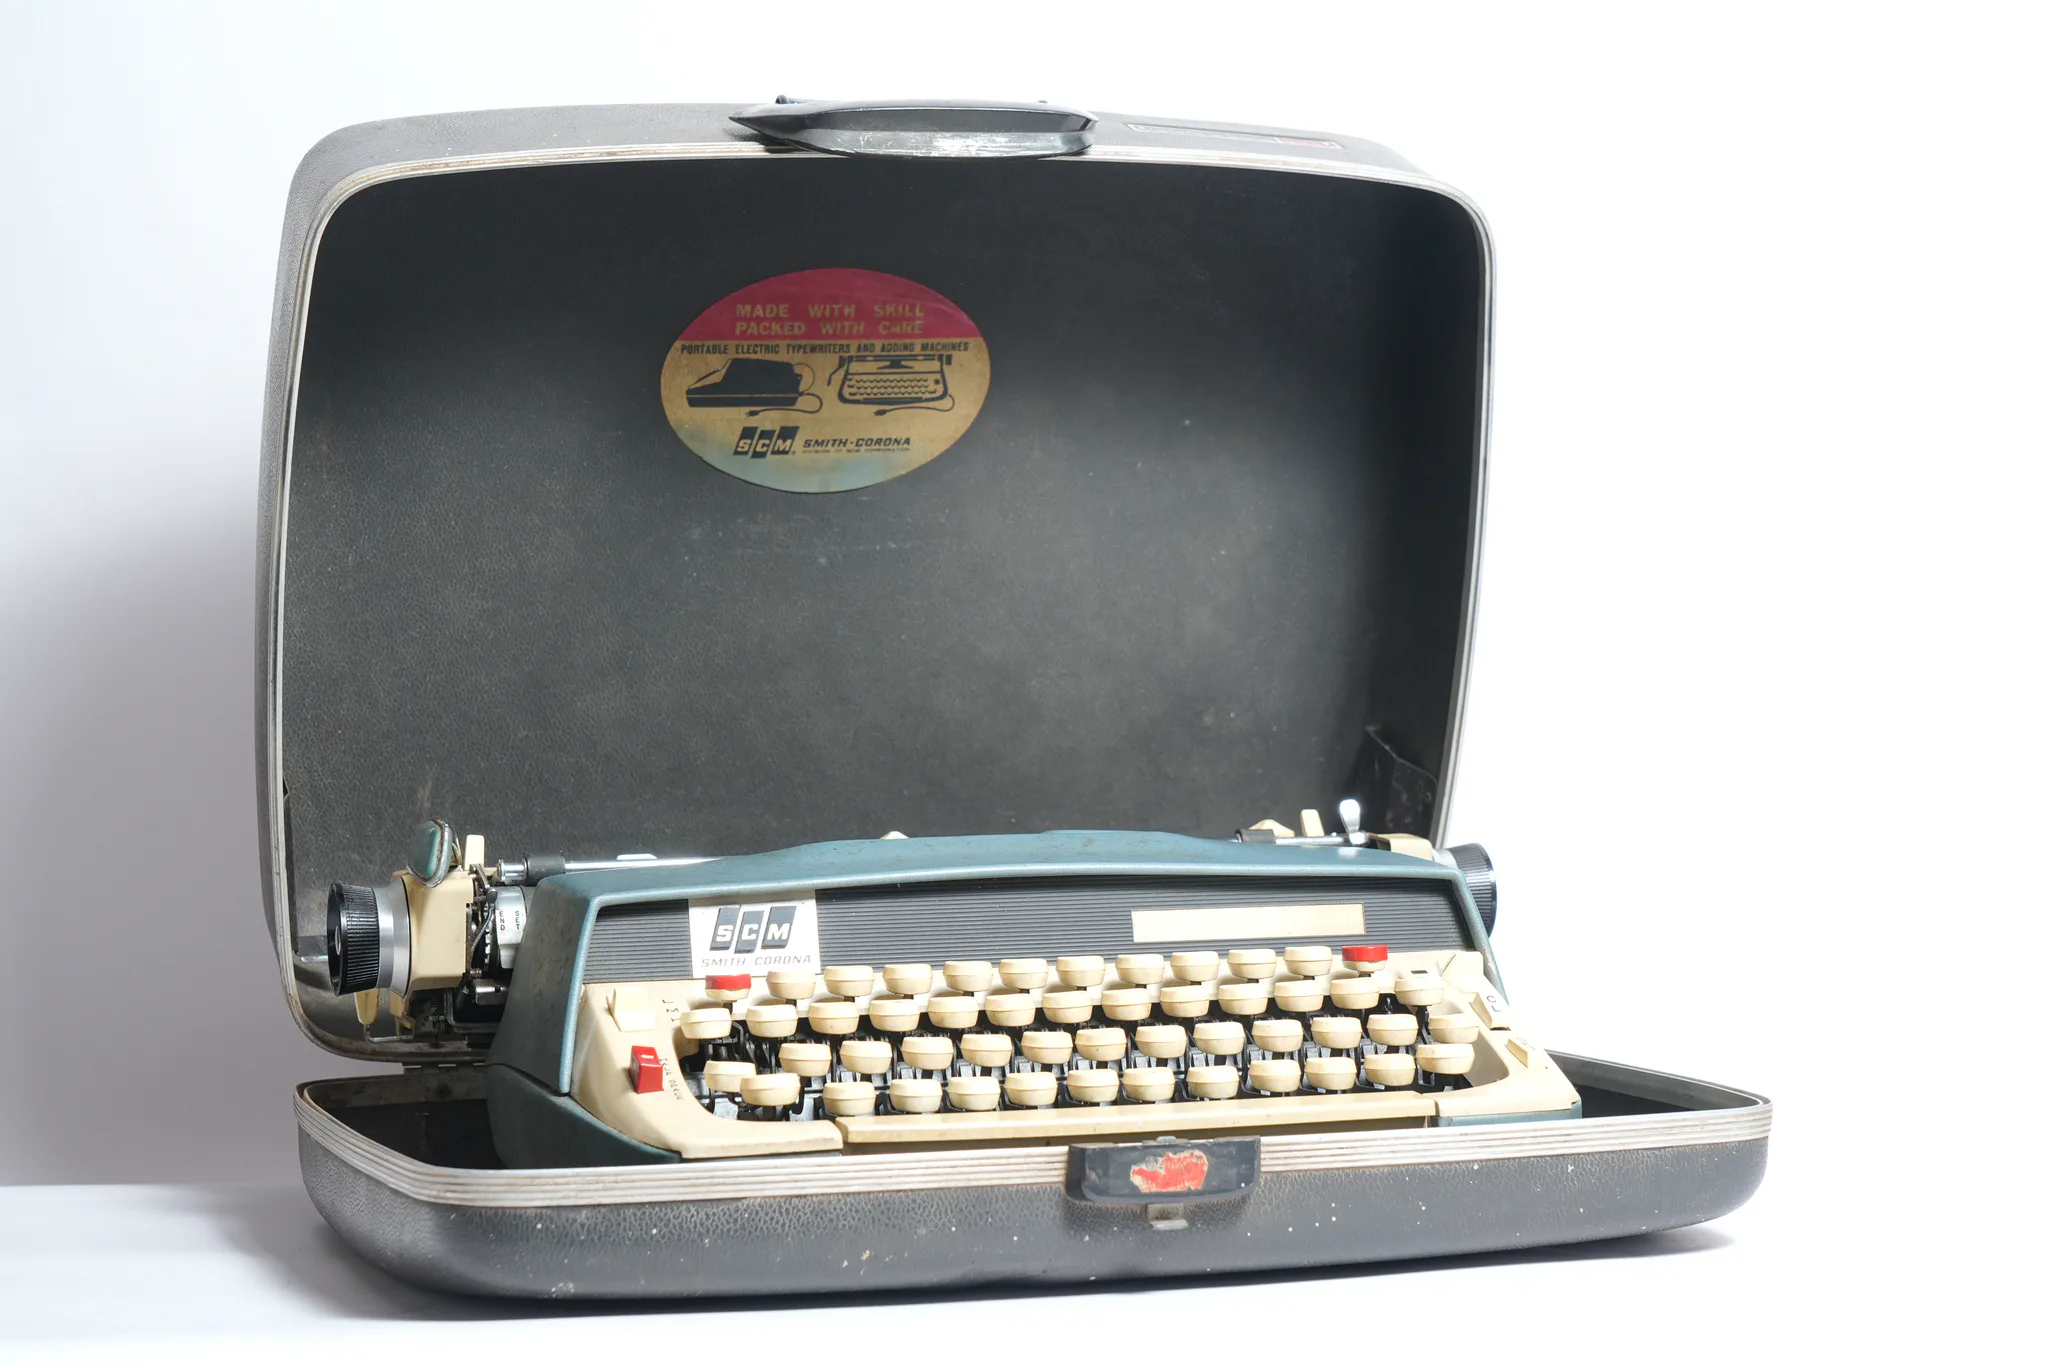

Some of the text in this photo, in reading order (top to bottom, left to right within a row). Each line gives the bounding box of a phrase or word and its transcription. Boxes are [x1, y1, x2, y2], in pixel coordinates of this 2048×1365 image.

[736, 303, 924, 319] MADE WITH SKILL
[735, 320, 924, 336] PACKED WITH CARE
[681, 341, 969, 355] PORTABLE ELECTRIC TYPEWRITERS AND ADDING MACHINES
[701, 955, 812, 968] SMITH CORONA
